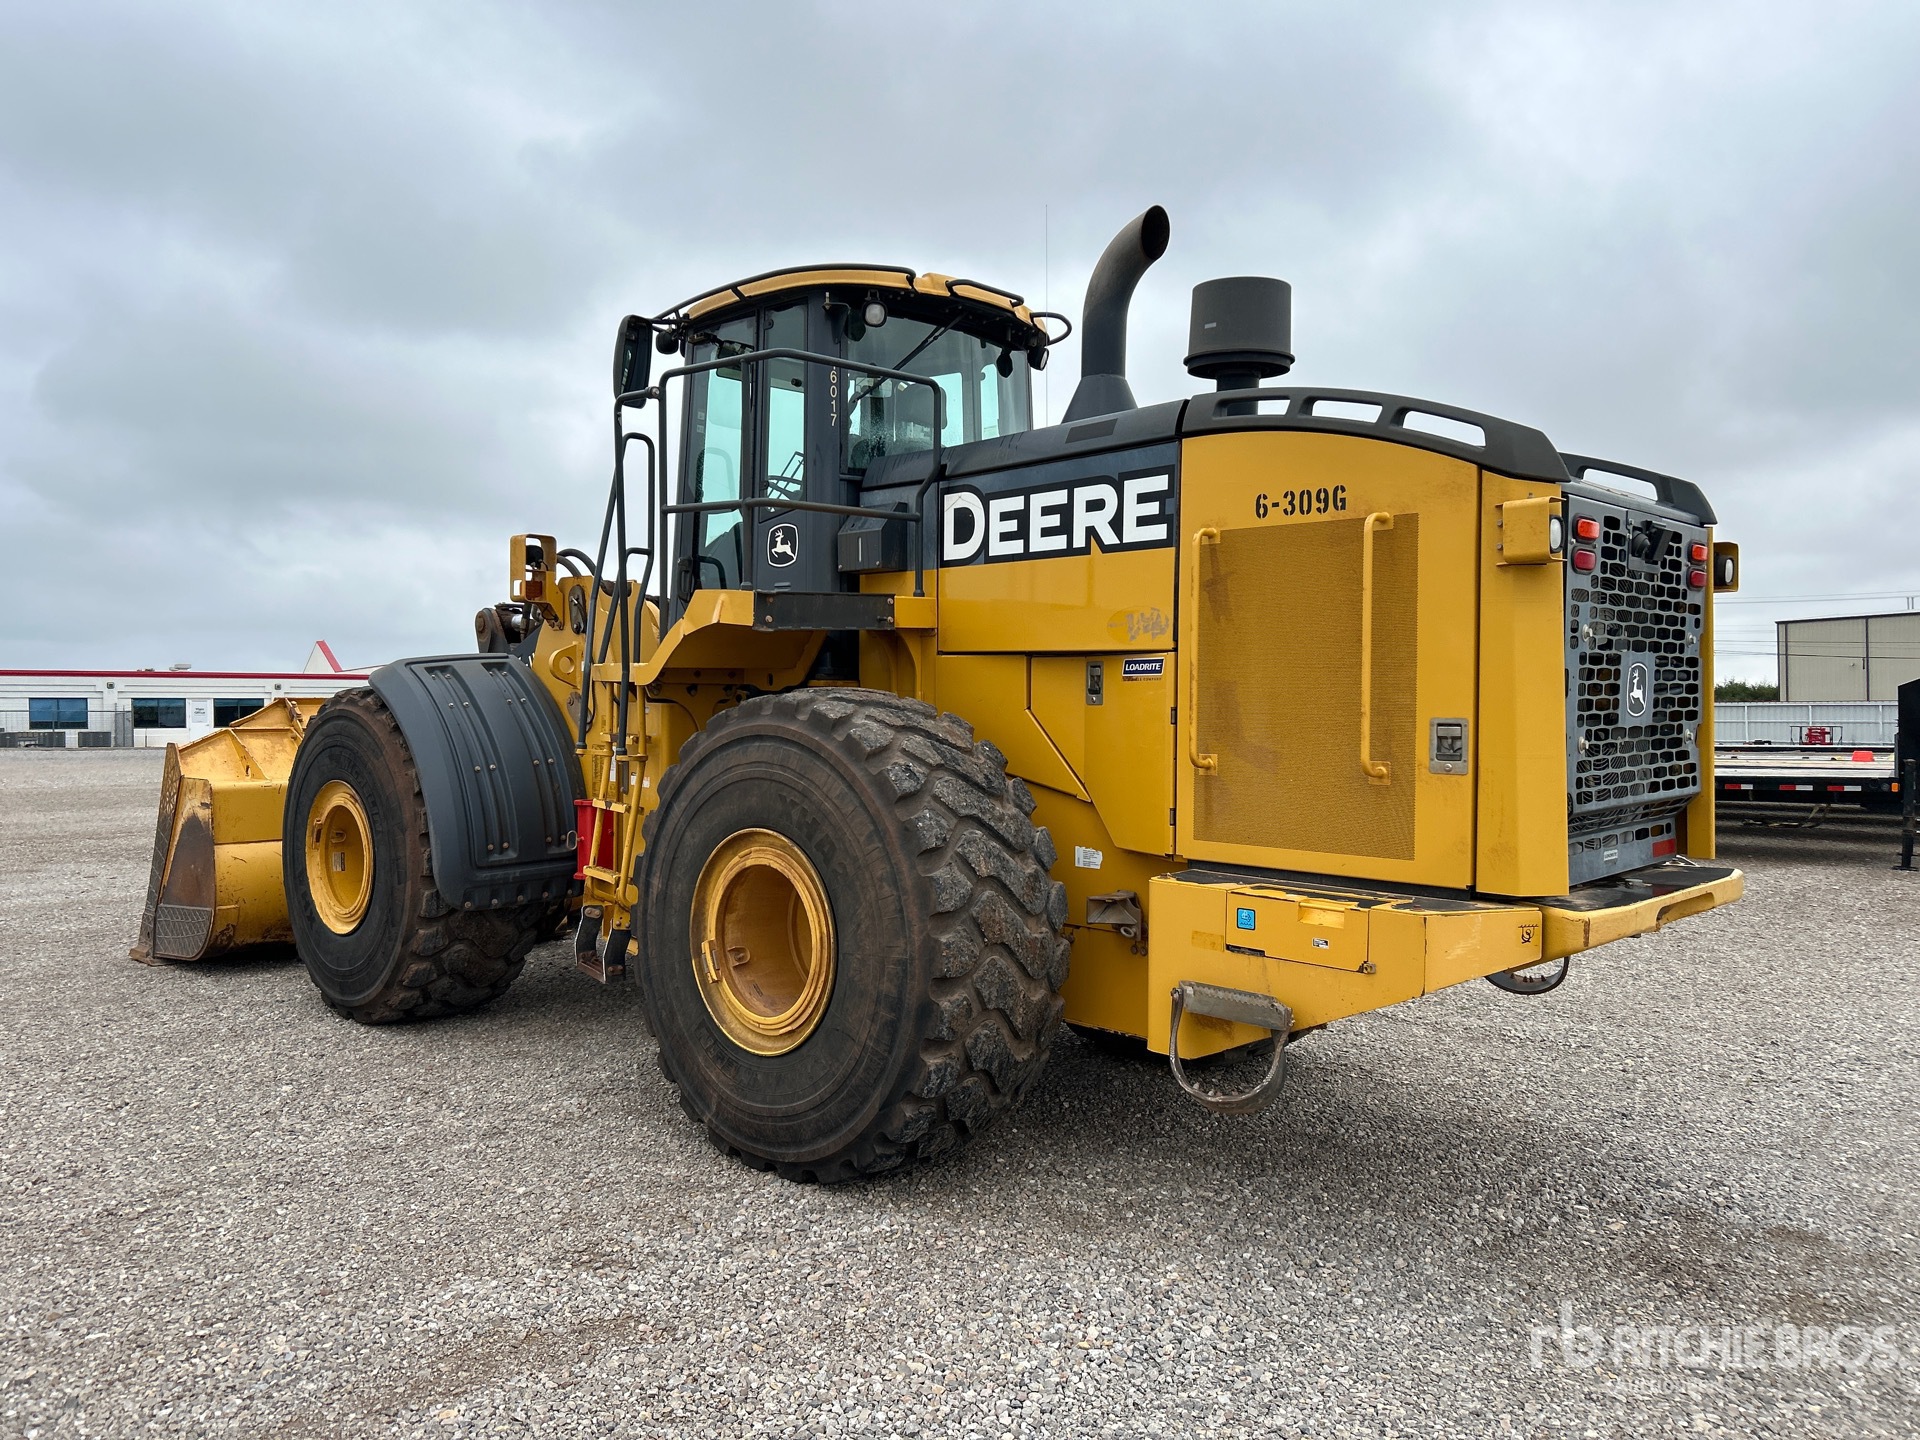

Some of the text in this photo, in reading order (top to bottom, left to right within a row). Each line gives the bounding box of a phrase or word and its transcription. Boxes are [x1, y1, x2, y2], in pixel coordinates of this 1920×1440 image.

[943, 474, 1169, 561] DEERE
[1255, 484, 1347, 519] 6-309G
[1125, 662, 1162, 671] LOADRITE
